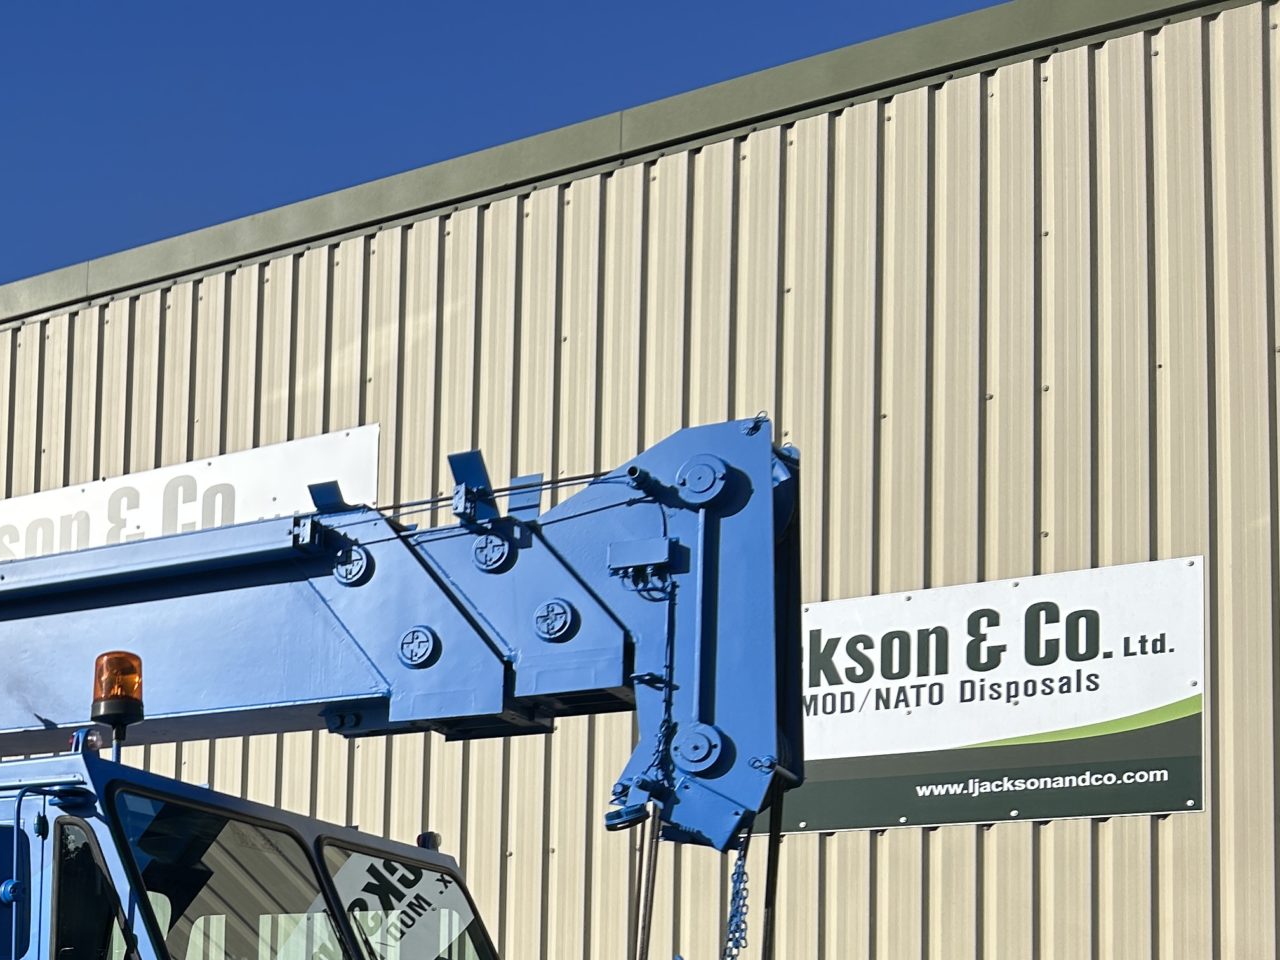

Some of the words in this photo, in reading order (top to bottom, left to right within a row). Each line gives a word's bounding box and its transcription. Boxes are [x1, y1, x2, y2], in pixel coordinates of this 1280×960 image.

[107, 485, 145, 546] &
[802, 626, 949, 688] kson
[966, 608, 1007, 672] &
[1024, 601, 1113, 666] Co.
[1123, 632, 1175, 657] Ltd.
[802, 682, 944, 717] MOD/NATO
[959, 668, 1100, 703] Disposals
